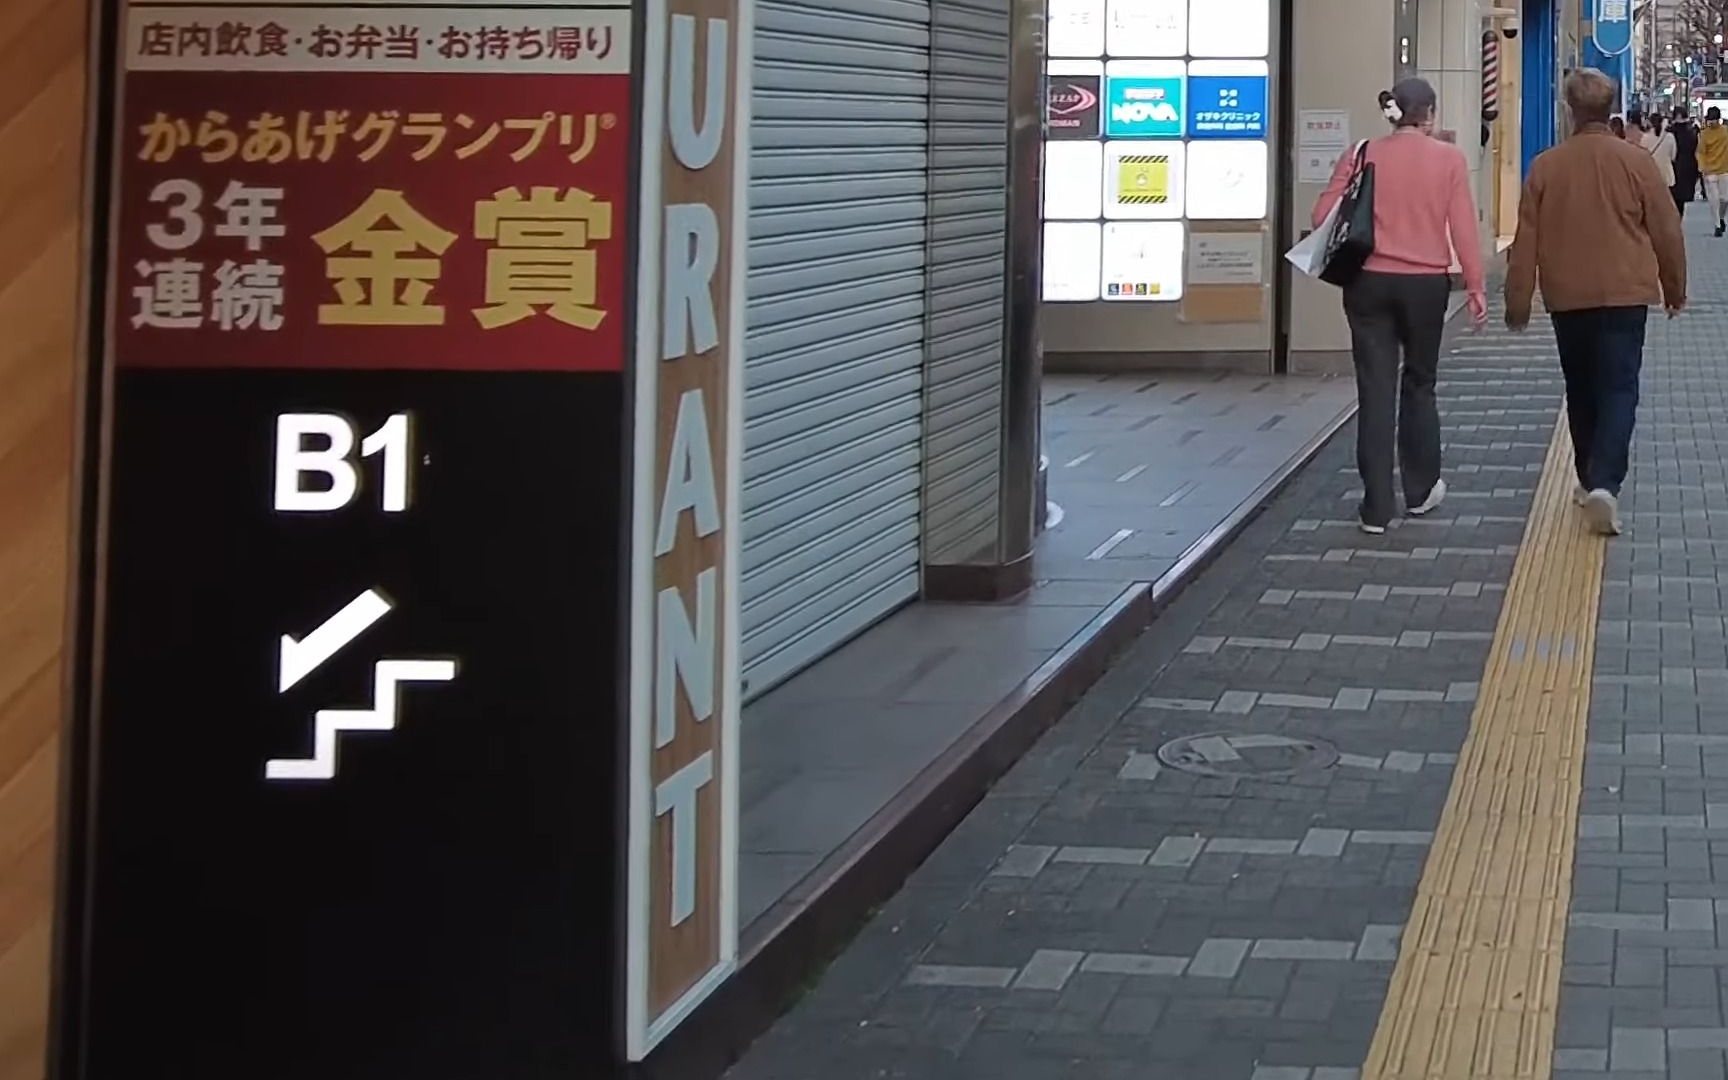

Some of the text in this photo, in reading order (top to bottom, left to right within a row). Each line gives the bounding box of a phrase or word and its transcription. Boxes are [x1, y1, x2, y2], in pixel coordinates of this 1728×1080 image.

[1112, 101, 1179, 124] NOVA
[145, 178, 287, 252] 3年
[132, 258, 285, 333] 連続
[310, 184, 613, 333] 金賞
[272, 412, 412, 514] B1
